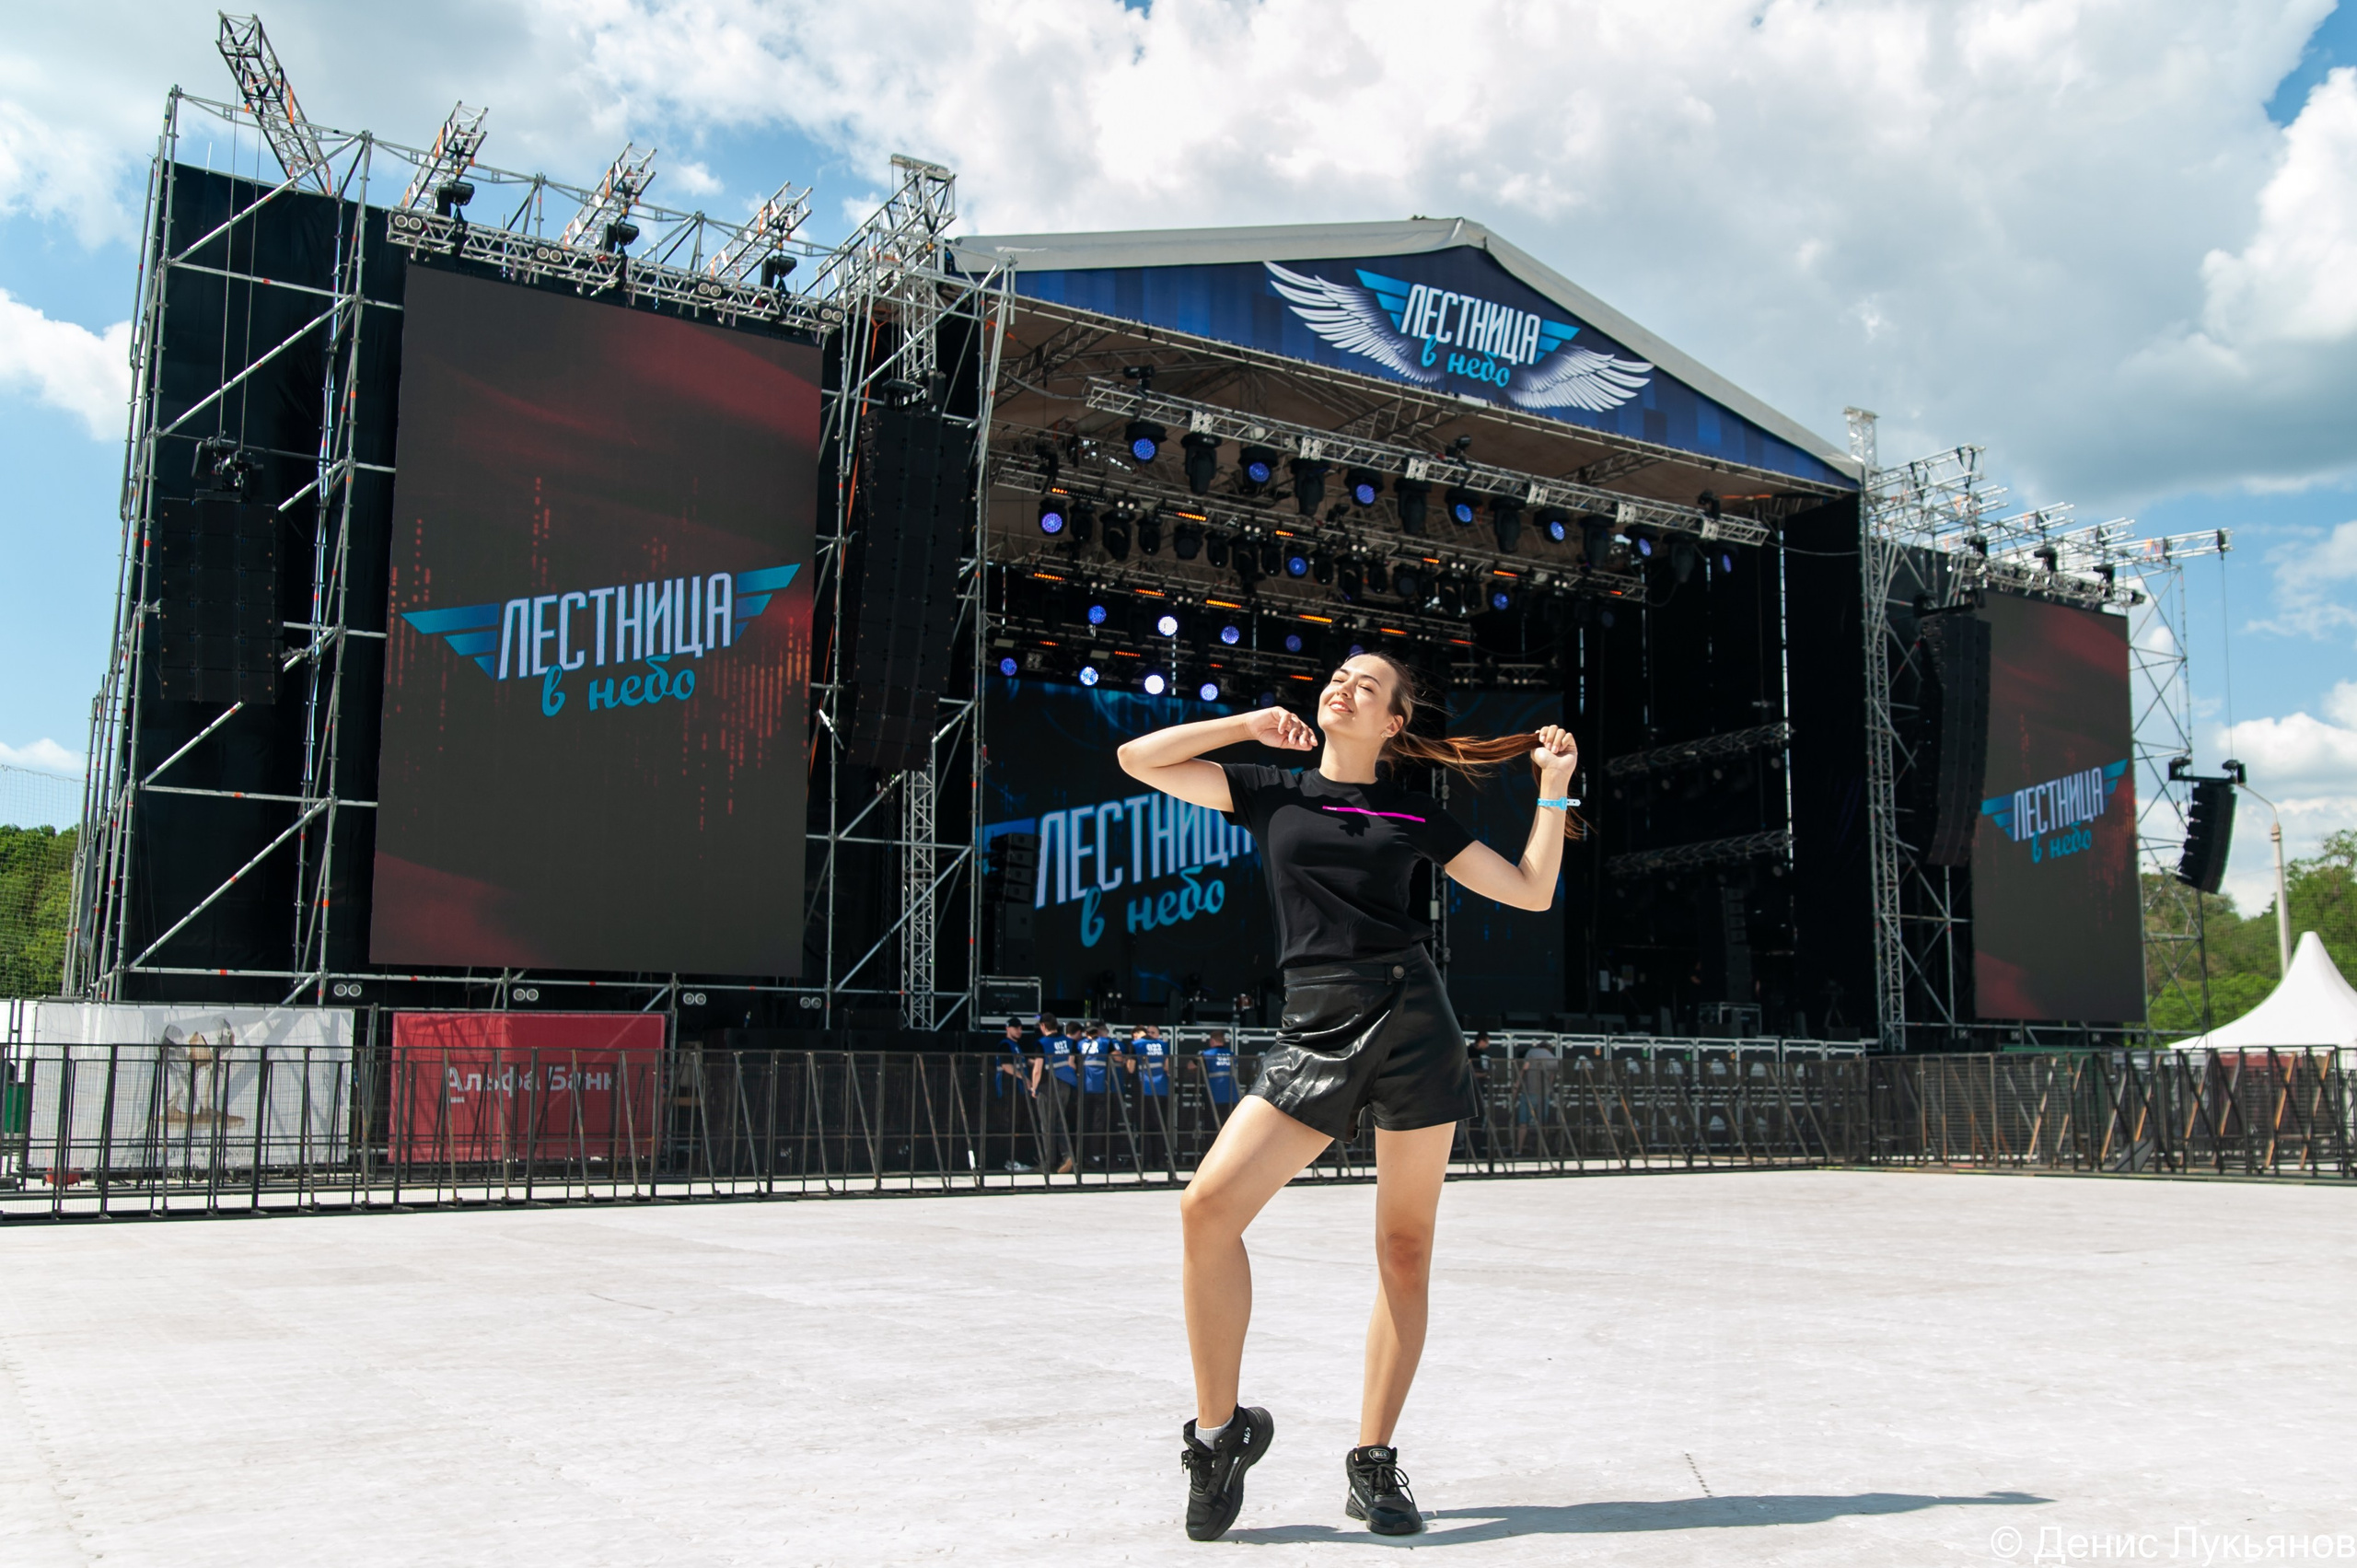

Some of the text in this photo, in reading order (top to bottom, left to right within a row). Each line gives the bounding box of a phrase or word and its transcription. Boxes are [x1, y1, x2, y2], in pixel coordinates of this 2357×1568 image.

[1400, 284, 1540, 365] ЛЕСТНИЦА
[1421, 334, 1510, 388] в небо
[497, 572, 732, 681] ЛЕСТНИЦА
[541, 655, 696, 716] в небо
[2014, 767, 2105, 842] ЛЕСТНИЦА
[2031, 820, 2092, 864] в небо
[1080, 865, 1225, 947] в небо
